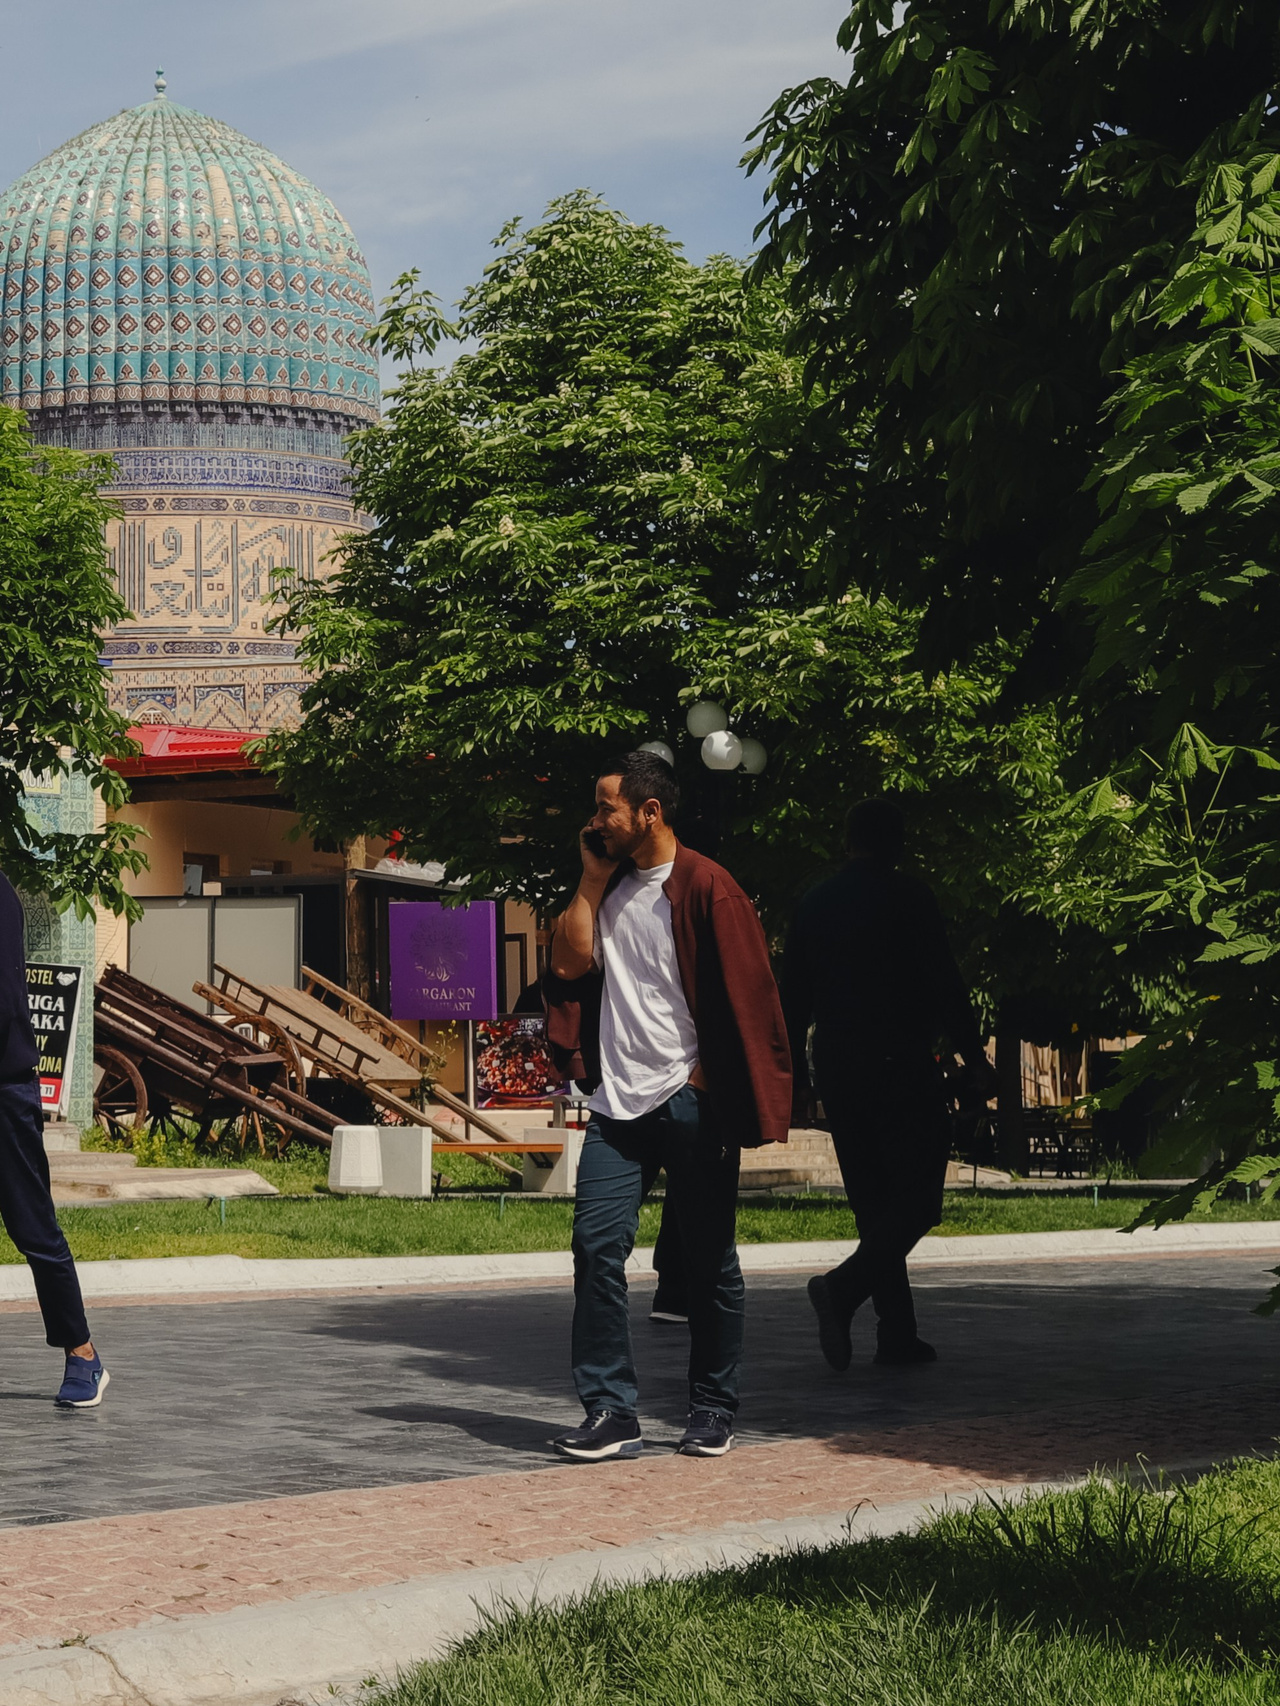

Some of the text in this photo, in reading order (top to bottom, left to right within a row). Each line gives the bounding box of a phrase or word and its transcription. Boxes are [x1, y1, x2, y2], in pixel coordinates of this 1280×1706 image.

[25, 968, 54, 985] OSTEL
[28, 993, 65, 1012] RIGA
[30, 1013, 65, 1031] AKA
[36, 1055, 62, 1073] ONA
